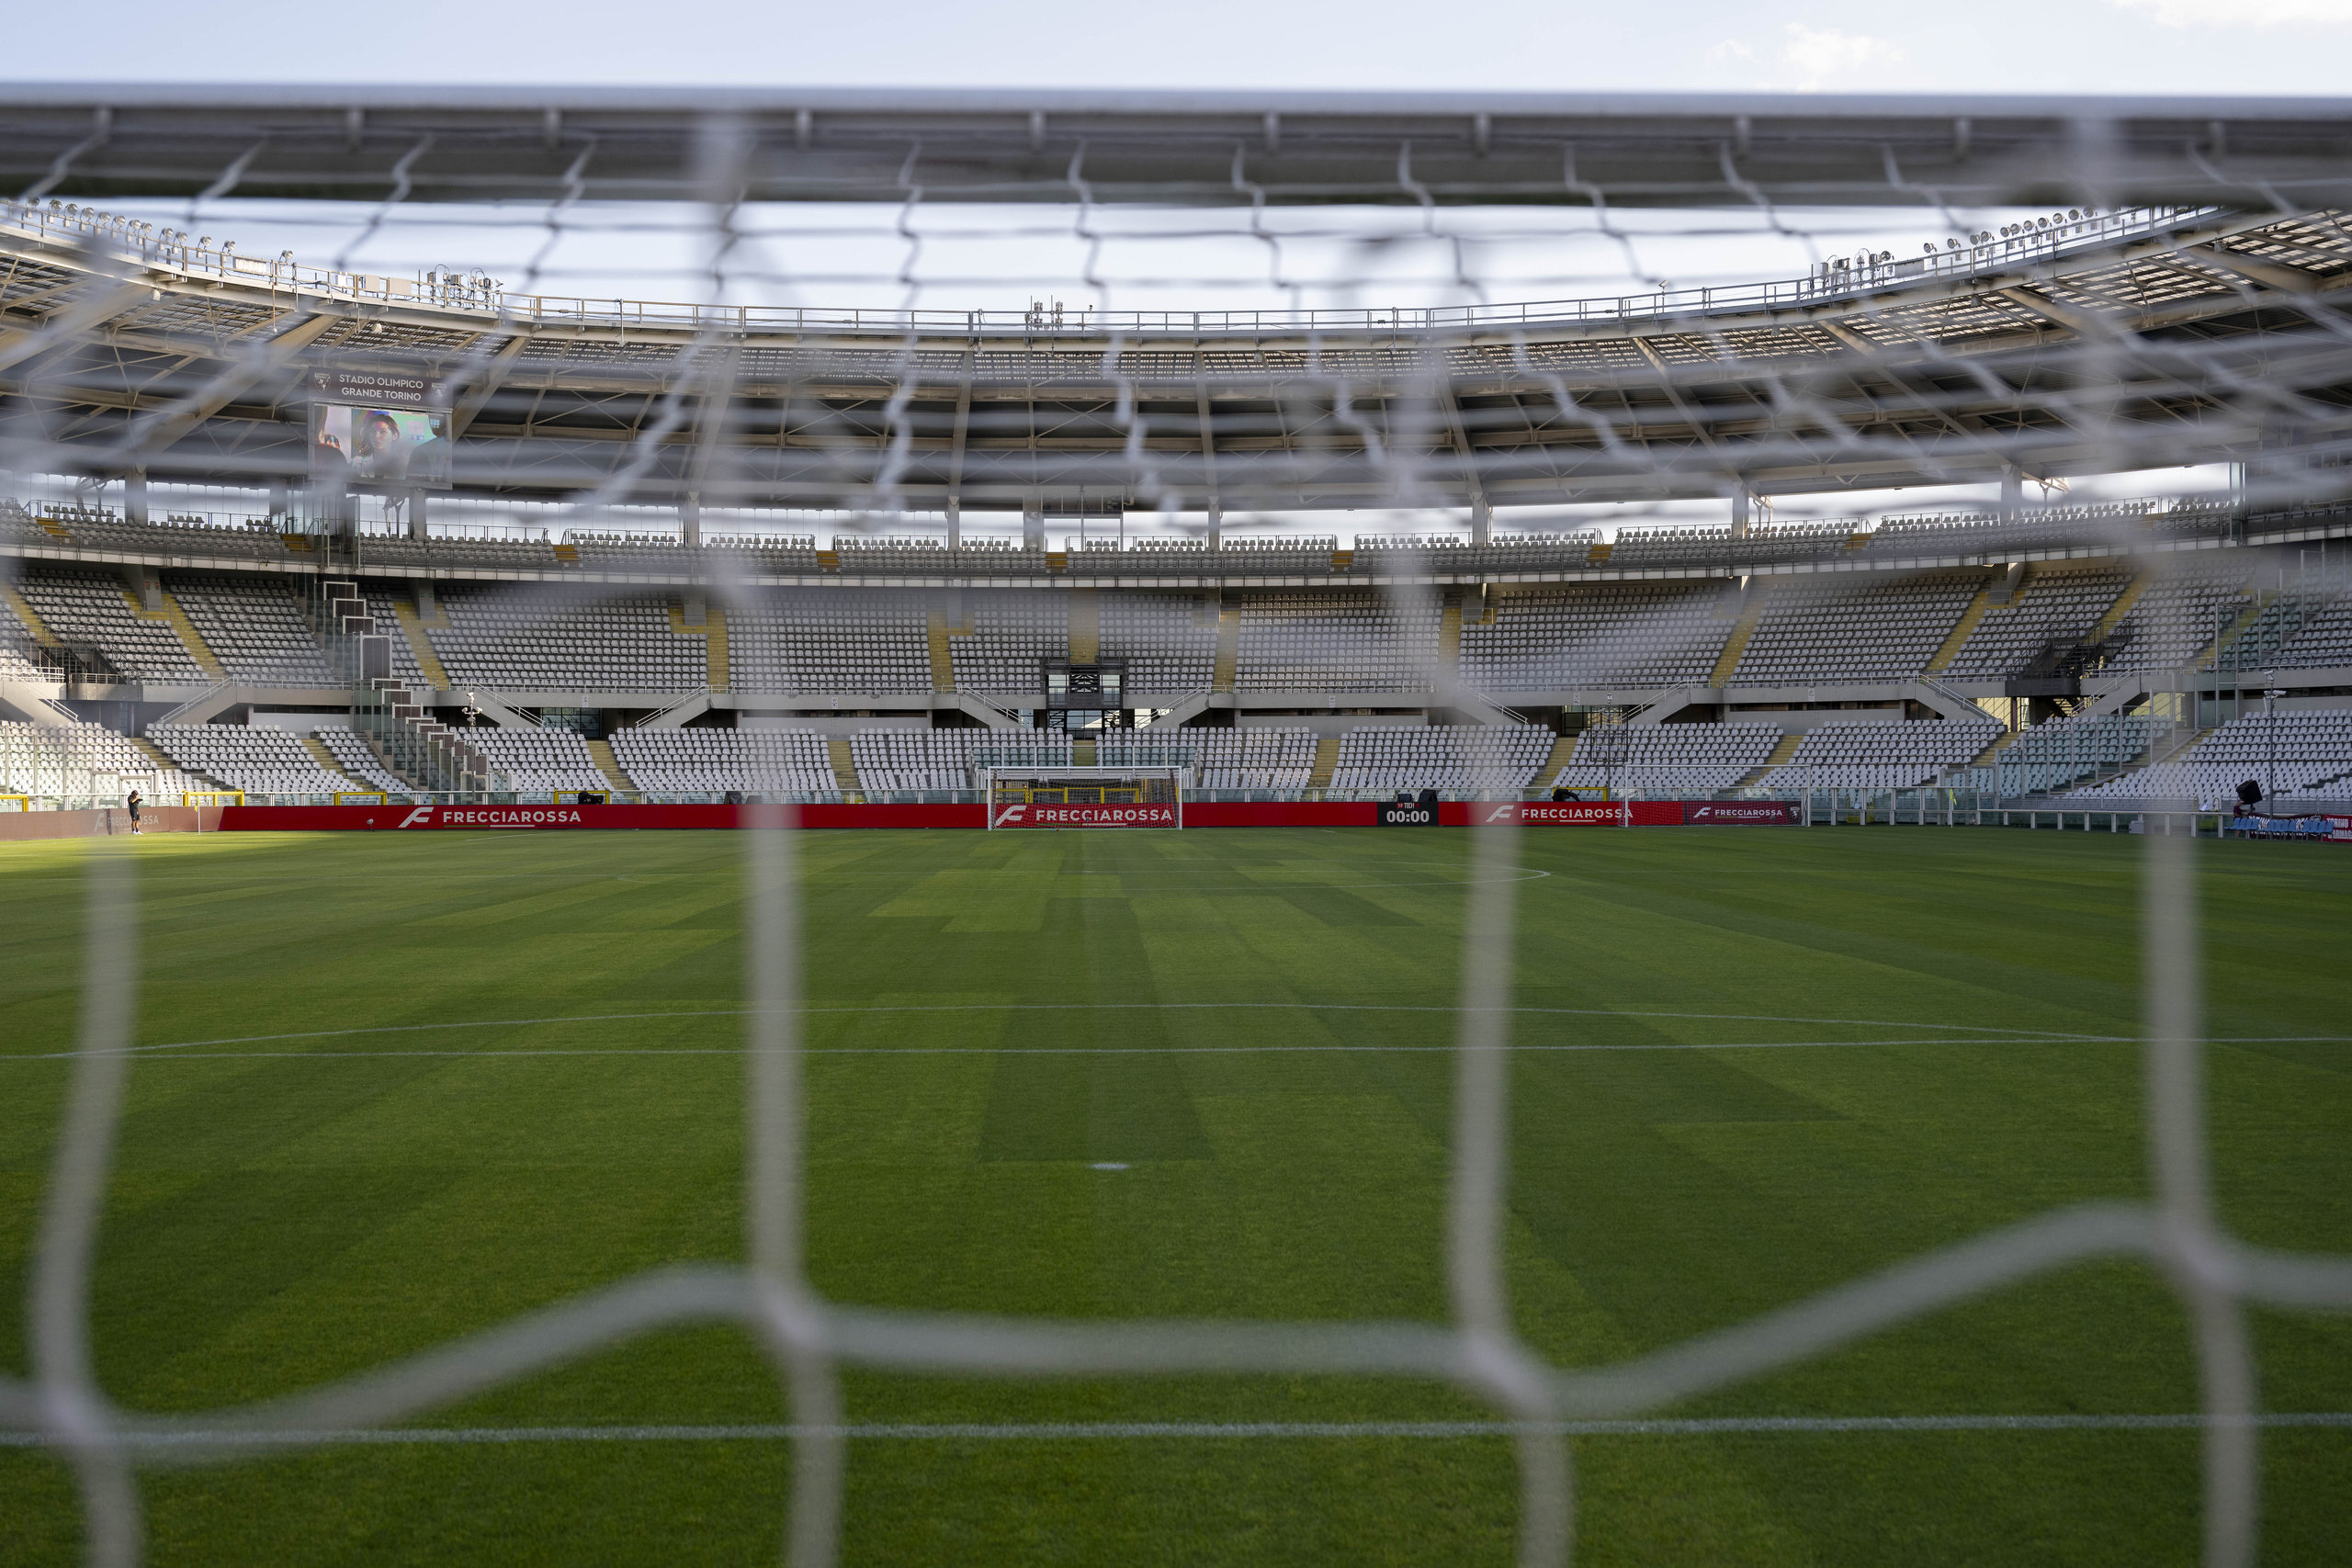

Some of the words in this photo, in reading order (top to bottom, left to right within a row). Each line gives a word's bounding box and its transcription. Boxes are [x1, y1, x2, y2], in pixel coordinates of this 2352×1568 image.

[339, 374, 375, 385] STADIO
[377, 377, 424, 389] OLIMPICO
[341, 387, 382, 398] GRANDE
[384, 390, 422, 401] TORINO
[443, 811, 582, 823] FRECCIAROSSA
[1035, 809, 1173, 821] FRECCIAROSSA
[1386, 810, 1430, 823] 00:00
[1521, 808, 1634, 818] FRECCIAROSSA
